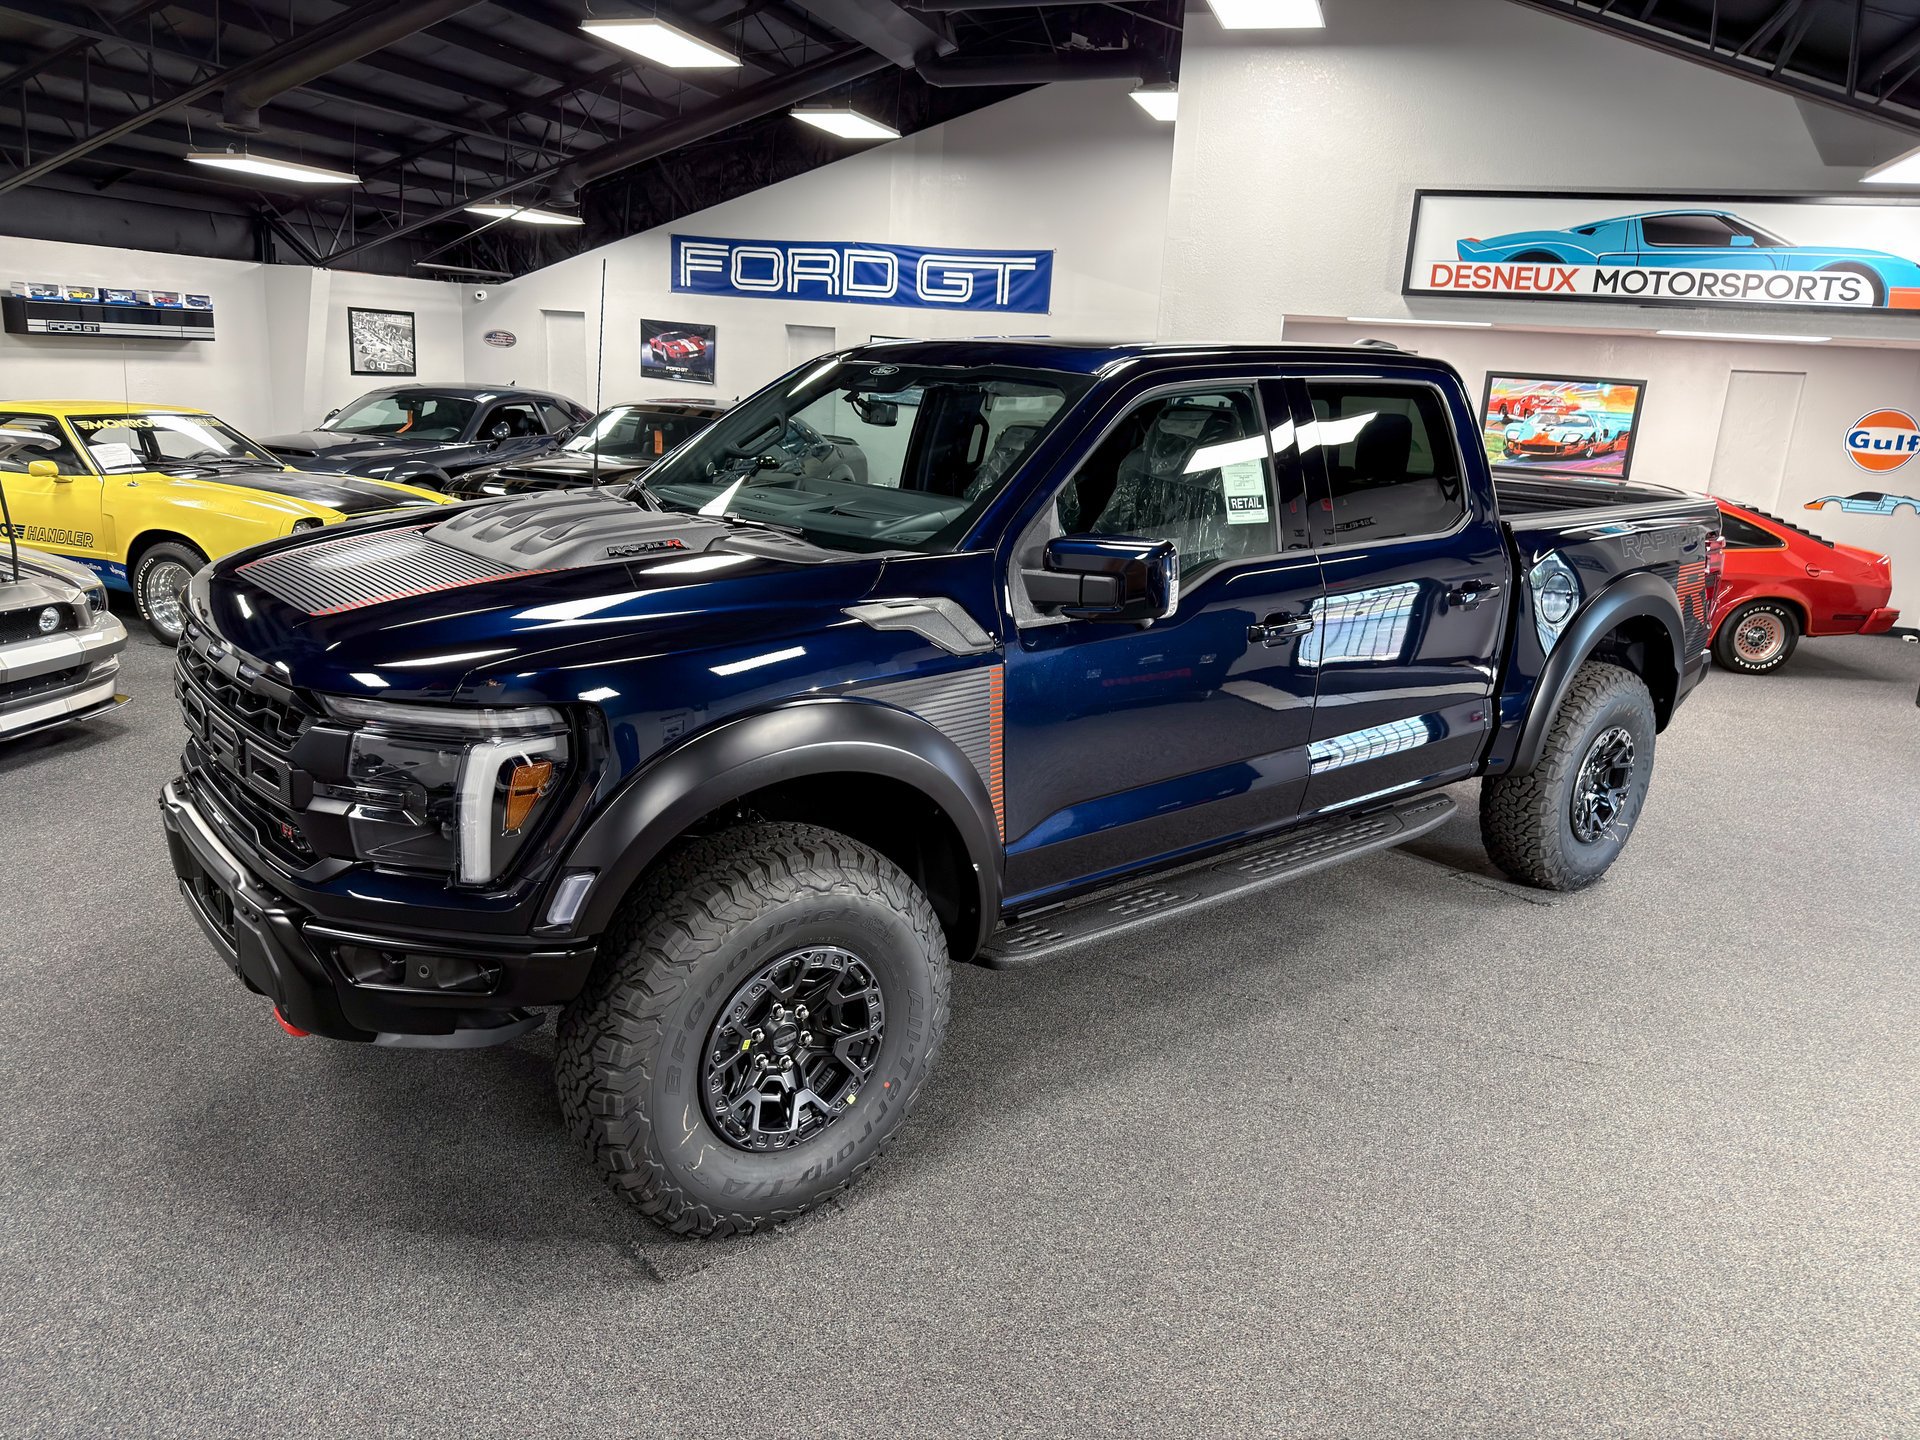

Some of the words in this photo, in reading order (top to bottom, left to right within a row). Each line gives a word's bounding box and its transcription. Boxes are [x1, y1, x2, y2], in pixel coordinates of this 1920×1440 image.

[680, 241, 899, 299] FORD
[916, 253, 1037, 305] GT
[1430, 263, 1580, 292] DESNEUX
[1592, 268, 1862, 302] MOTORSPORTS
[49, 321, 81, 331] FORD
[84, 323, 99, 332] GT
[1848, 430, 1920, 452] Gulf
[1230, 497, 1262, 509] RETAIL
[26, 525, 94, 548] HANDLER
[1620, 527, 1704, 566] RAPTOR
[1743, 605, 1772, 618] EAGLE
[1774, 608, 1785, 617] ST
[1734, 654, 1784, 670] GOODYEAR
[664, 909, 859, 1096] BFGoodrich
